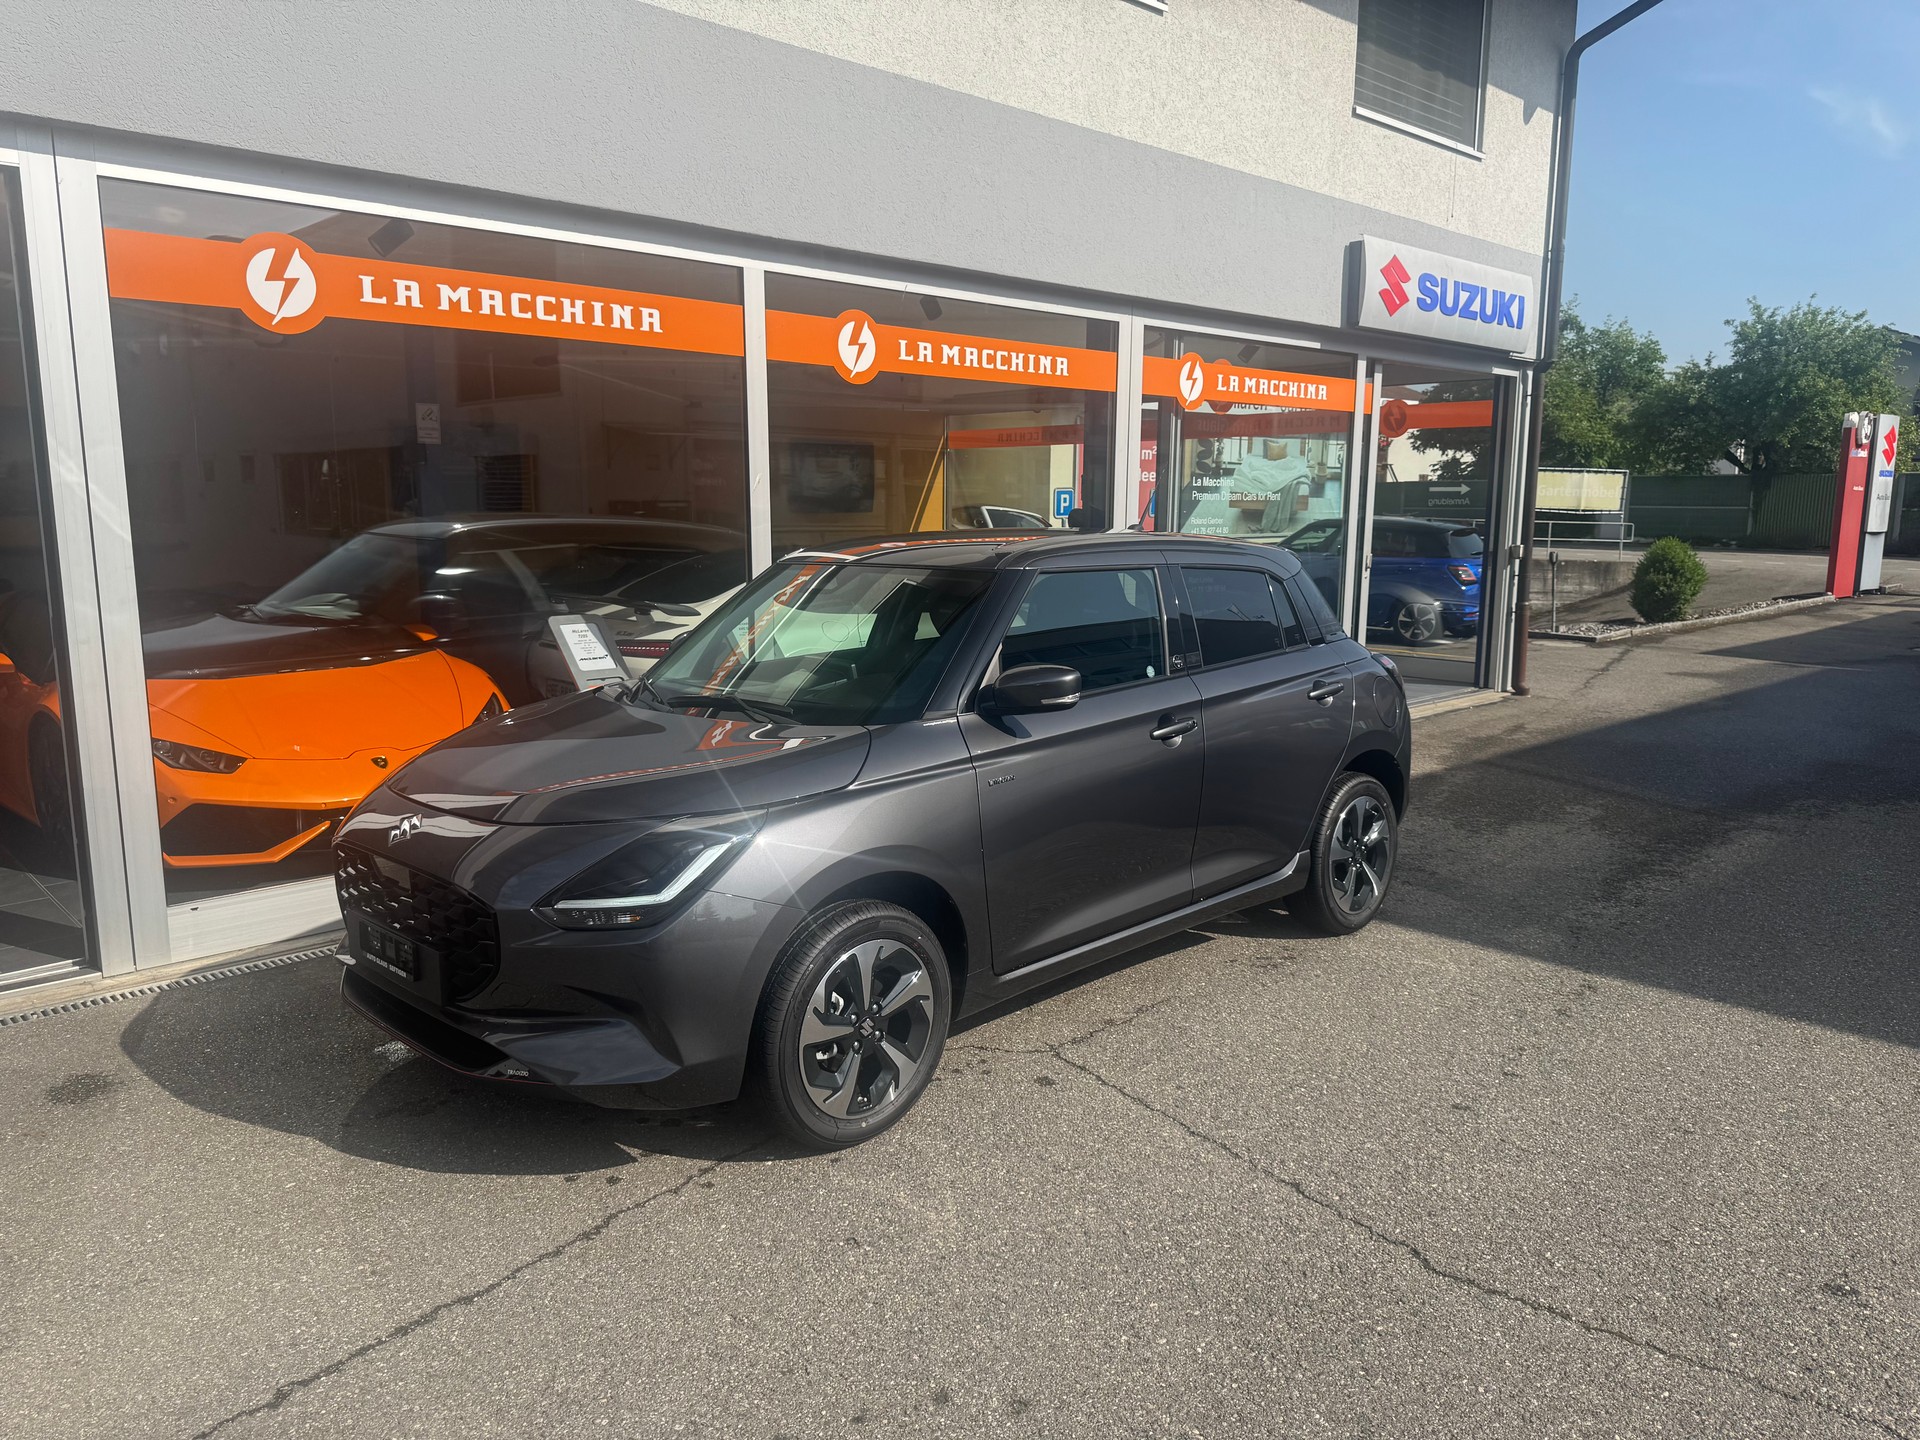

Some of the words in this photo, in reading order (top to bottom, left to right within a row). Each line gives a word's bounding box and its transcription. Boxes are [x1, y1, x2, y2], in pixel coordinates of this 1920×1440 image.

[358, 275, 424, 308] LA
[436, 283, 663, 333] MACCHINA
[1417, 272, 1525, 330] SUZUKI
[898, 339, 934, 363] LA
[941, 344, 1069, 376] MACCHINA
[1217, 374, 1239, 392] LA
[1244, 376, 1327, 400] MACCHINA
[1139, 468, 1156, 482] ee
[1192, 476, 1201, 487] La
[1203, 476, 1235, 487] Macchina
[1060, 494, 1070, 513] P
[1192, 491, 1220, 501] Premium
[1242, 491, 1257, 501] Cars
[1258, 491, 1266, 500] for
[1266, 491, 1281, 501] Rent
